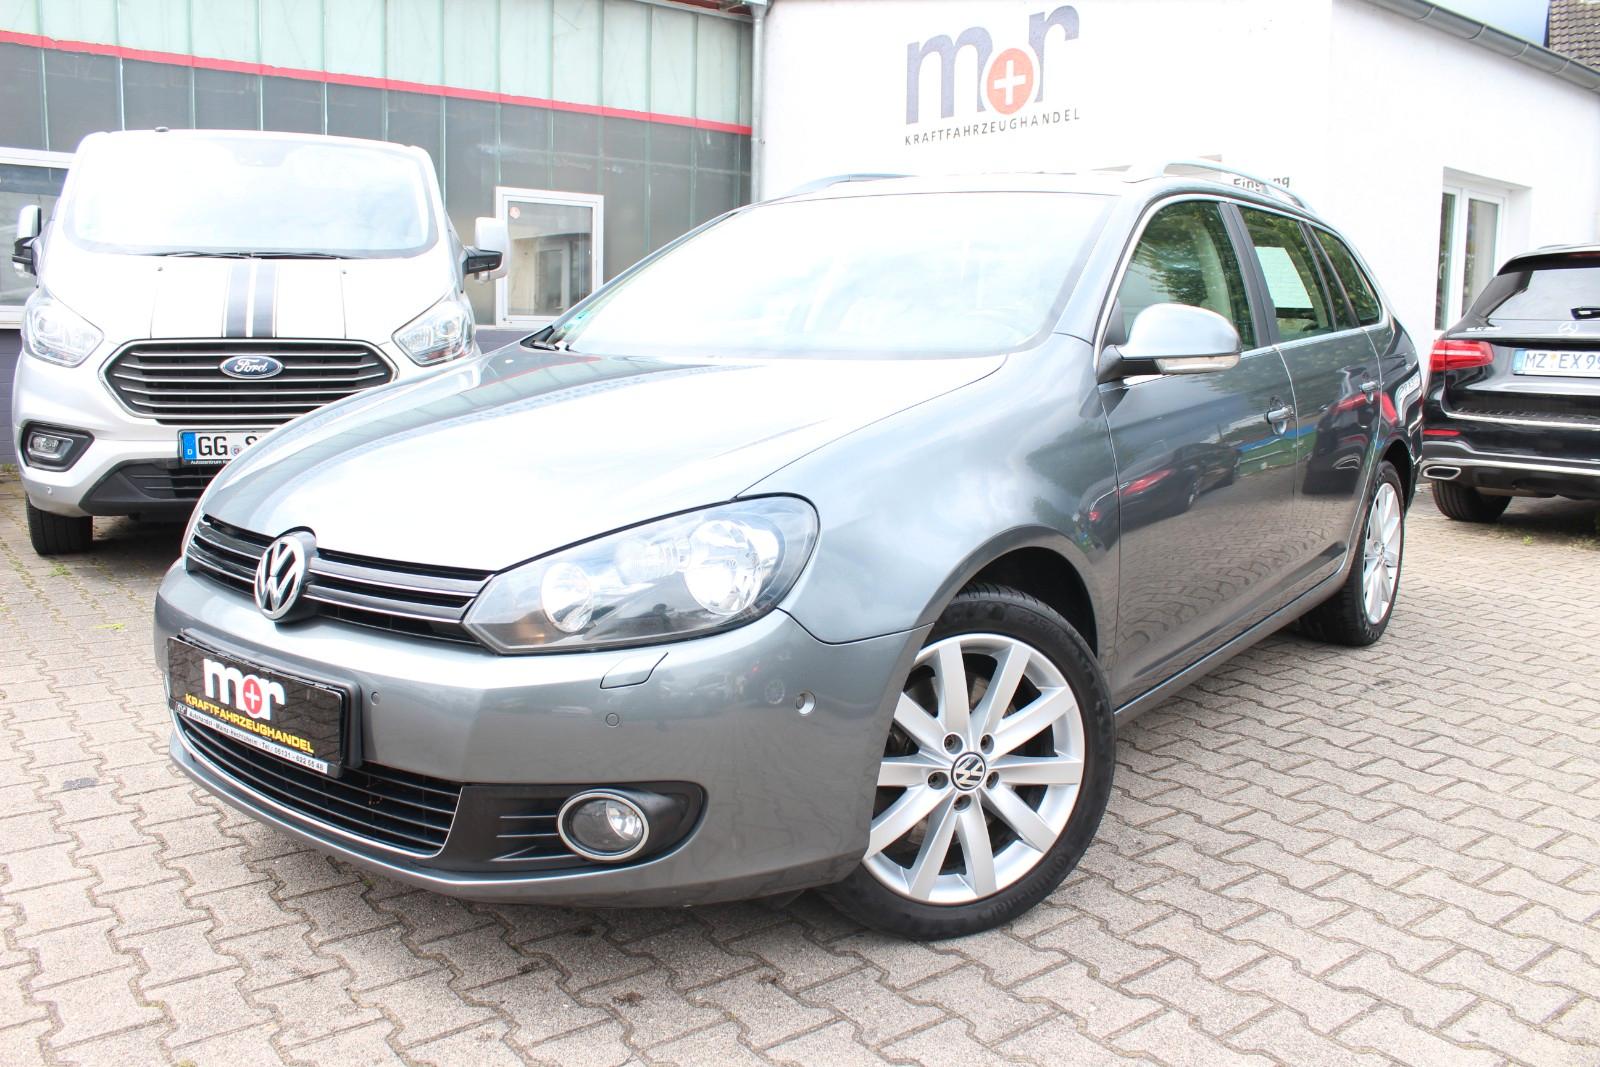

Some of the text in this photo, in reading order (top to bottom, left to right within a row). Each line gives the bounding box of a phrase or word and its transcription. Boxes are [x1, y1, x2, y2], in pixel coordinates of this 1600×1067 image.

[905, 107, 1080, 146] KRAFTFAHRZEUGHANDEL
[233, 358, 268, 373] Ford
[1524, 353, 1548, 369] MZ
[1558, 353, 1583, 369] EX
[197, 435, 228, 456] GG
[185, 693, 314, 754] KRAFTFAHRZEUGHANDEL
